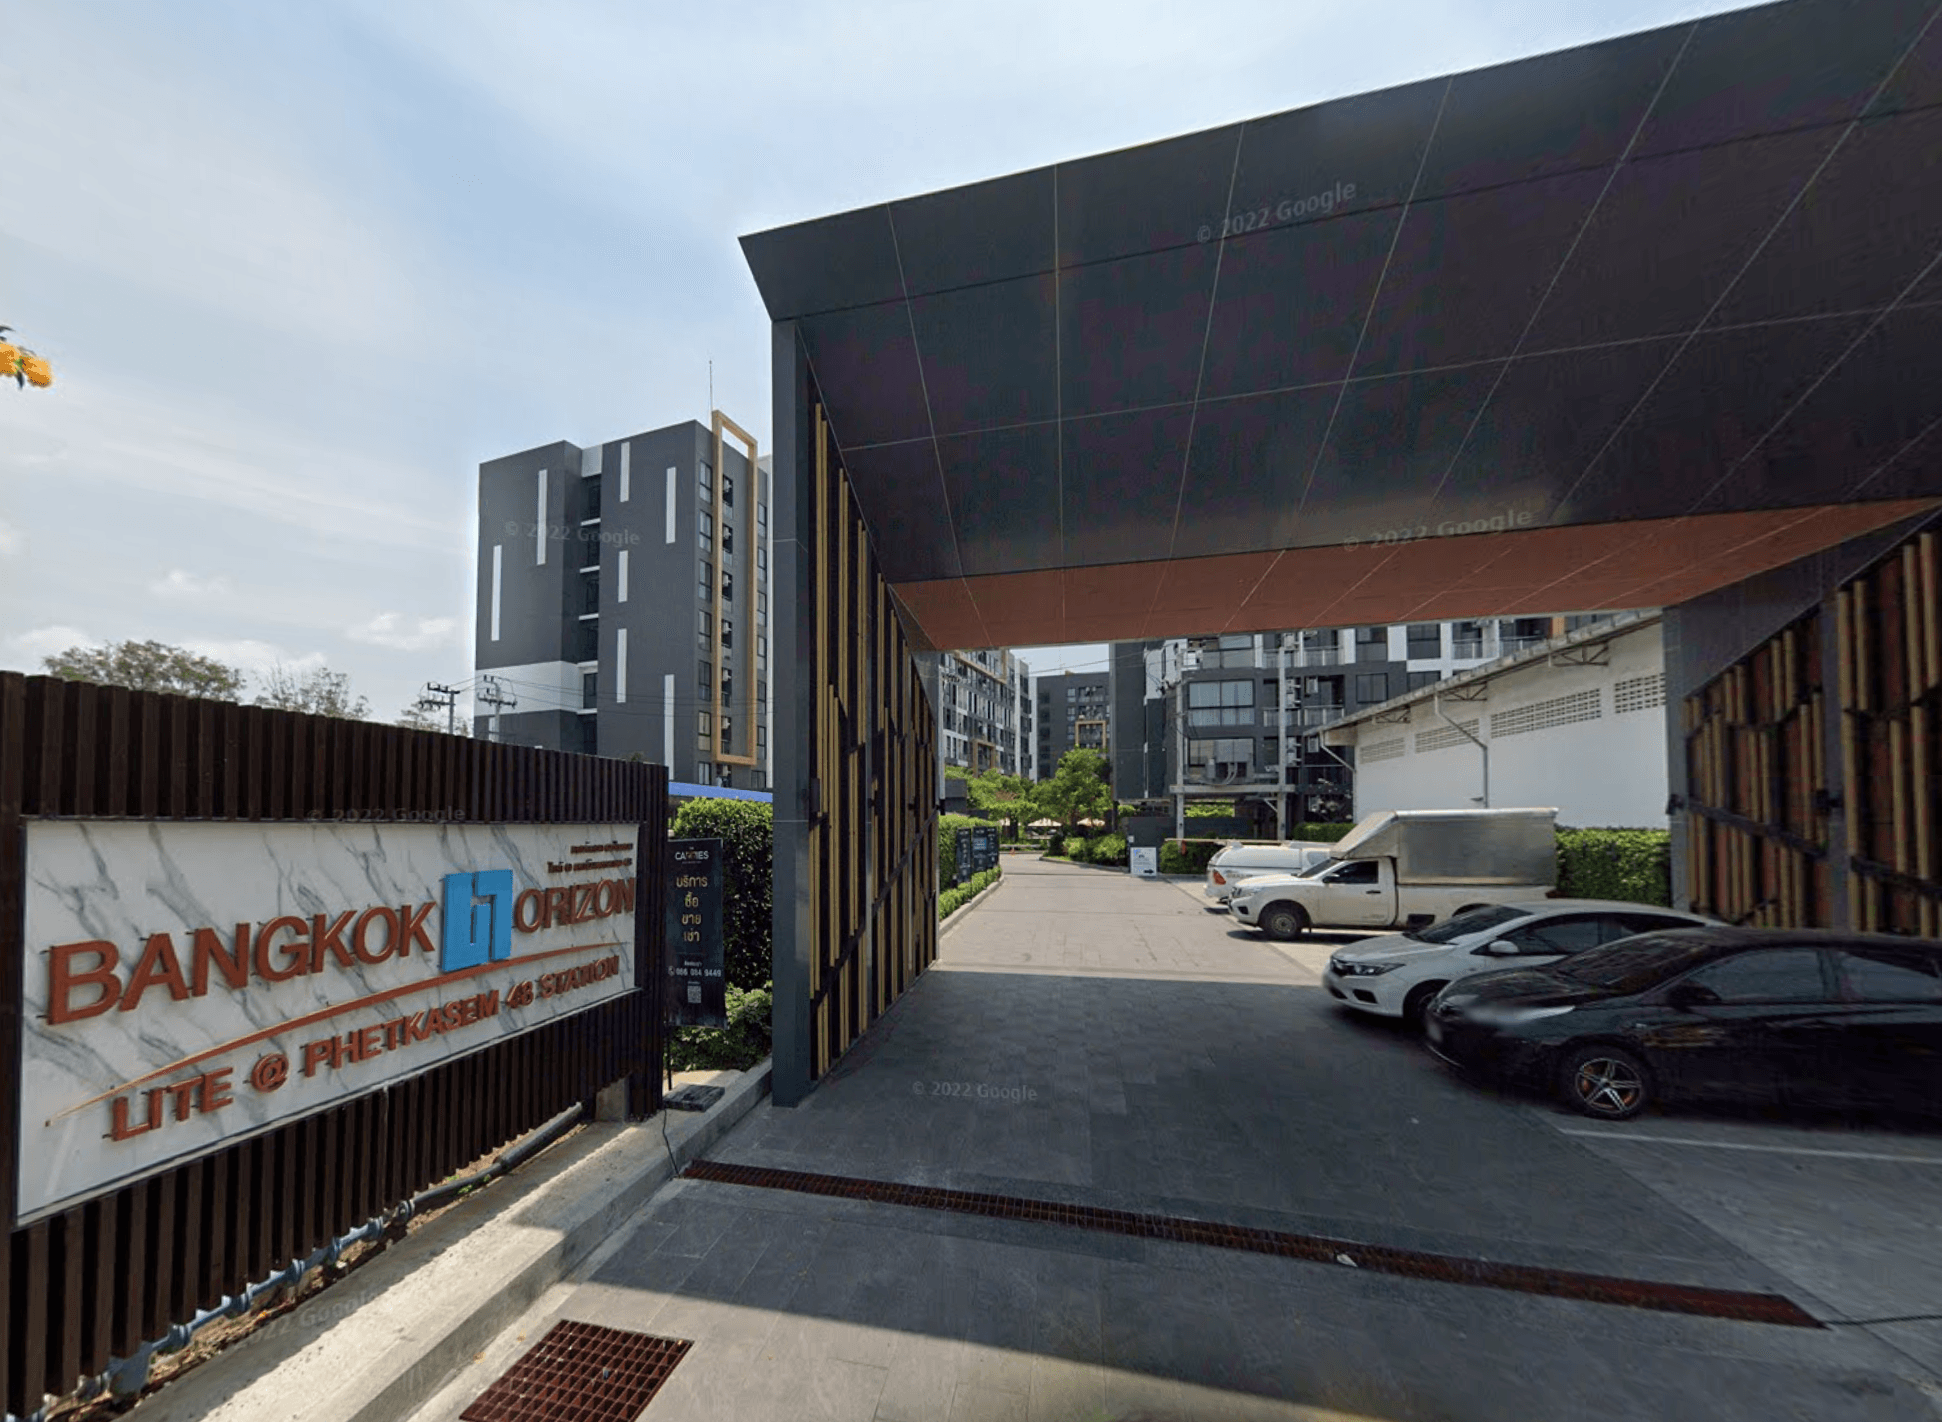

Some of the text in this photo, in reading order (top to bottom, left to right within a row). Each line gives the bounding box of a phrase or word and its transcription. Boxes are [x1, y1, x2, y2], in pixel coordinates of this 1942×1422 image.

[676, 874, 708, 888] บริการ
[682, 914, 702, 925] ขาย
[683, 928, 700, 942] เช่า
[46, 902, 438, 1026] BANGKOK
[111, 954, 620, 1142] LITE @ PHETKASEM 48 STATION
